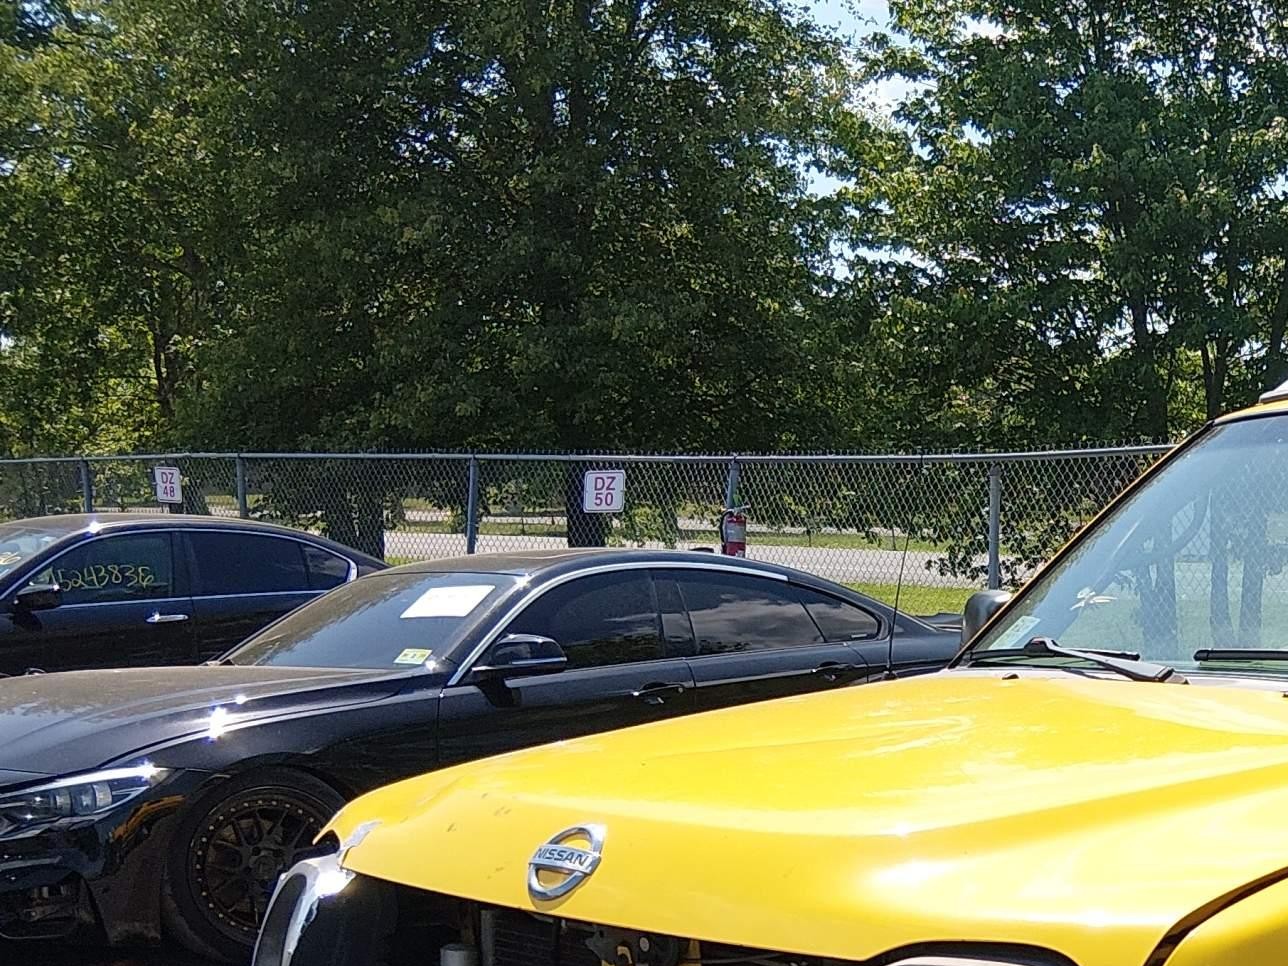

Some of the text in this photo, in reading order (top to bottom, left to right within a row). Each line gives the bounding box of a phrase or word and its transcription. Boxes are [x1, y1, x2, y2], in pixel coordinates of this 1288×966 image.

[160, 471, 175, 485] DZ
[594, 476, 616, 491] DZ
[162, 485, 175, 498] 48
[594, 492, 614, 507] 50
[535, 847, 589, 866] NISSAN
